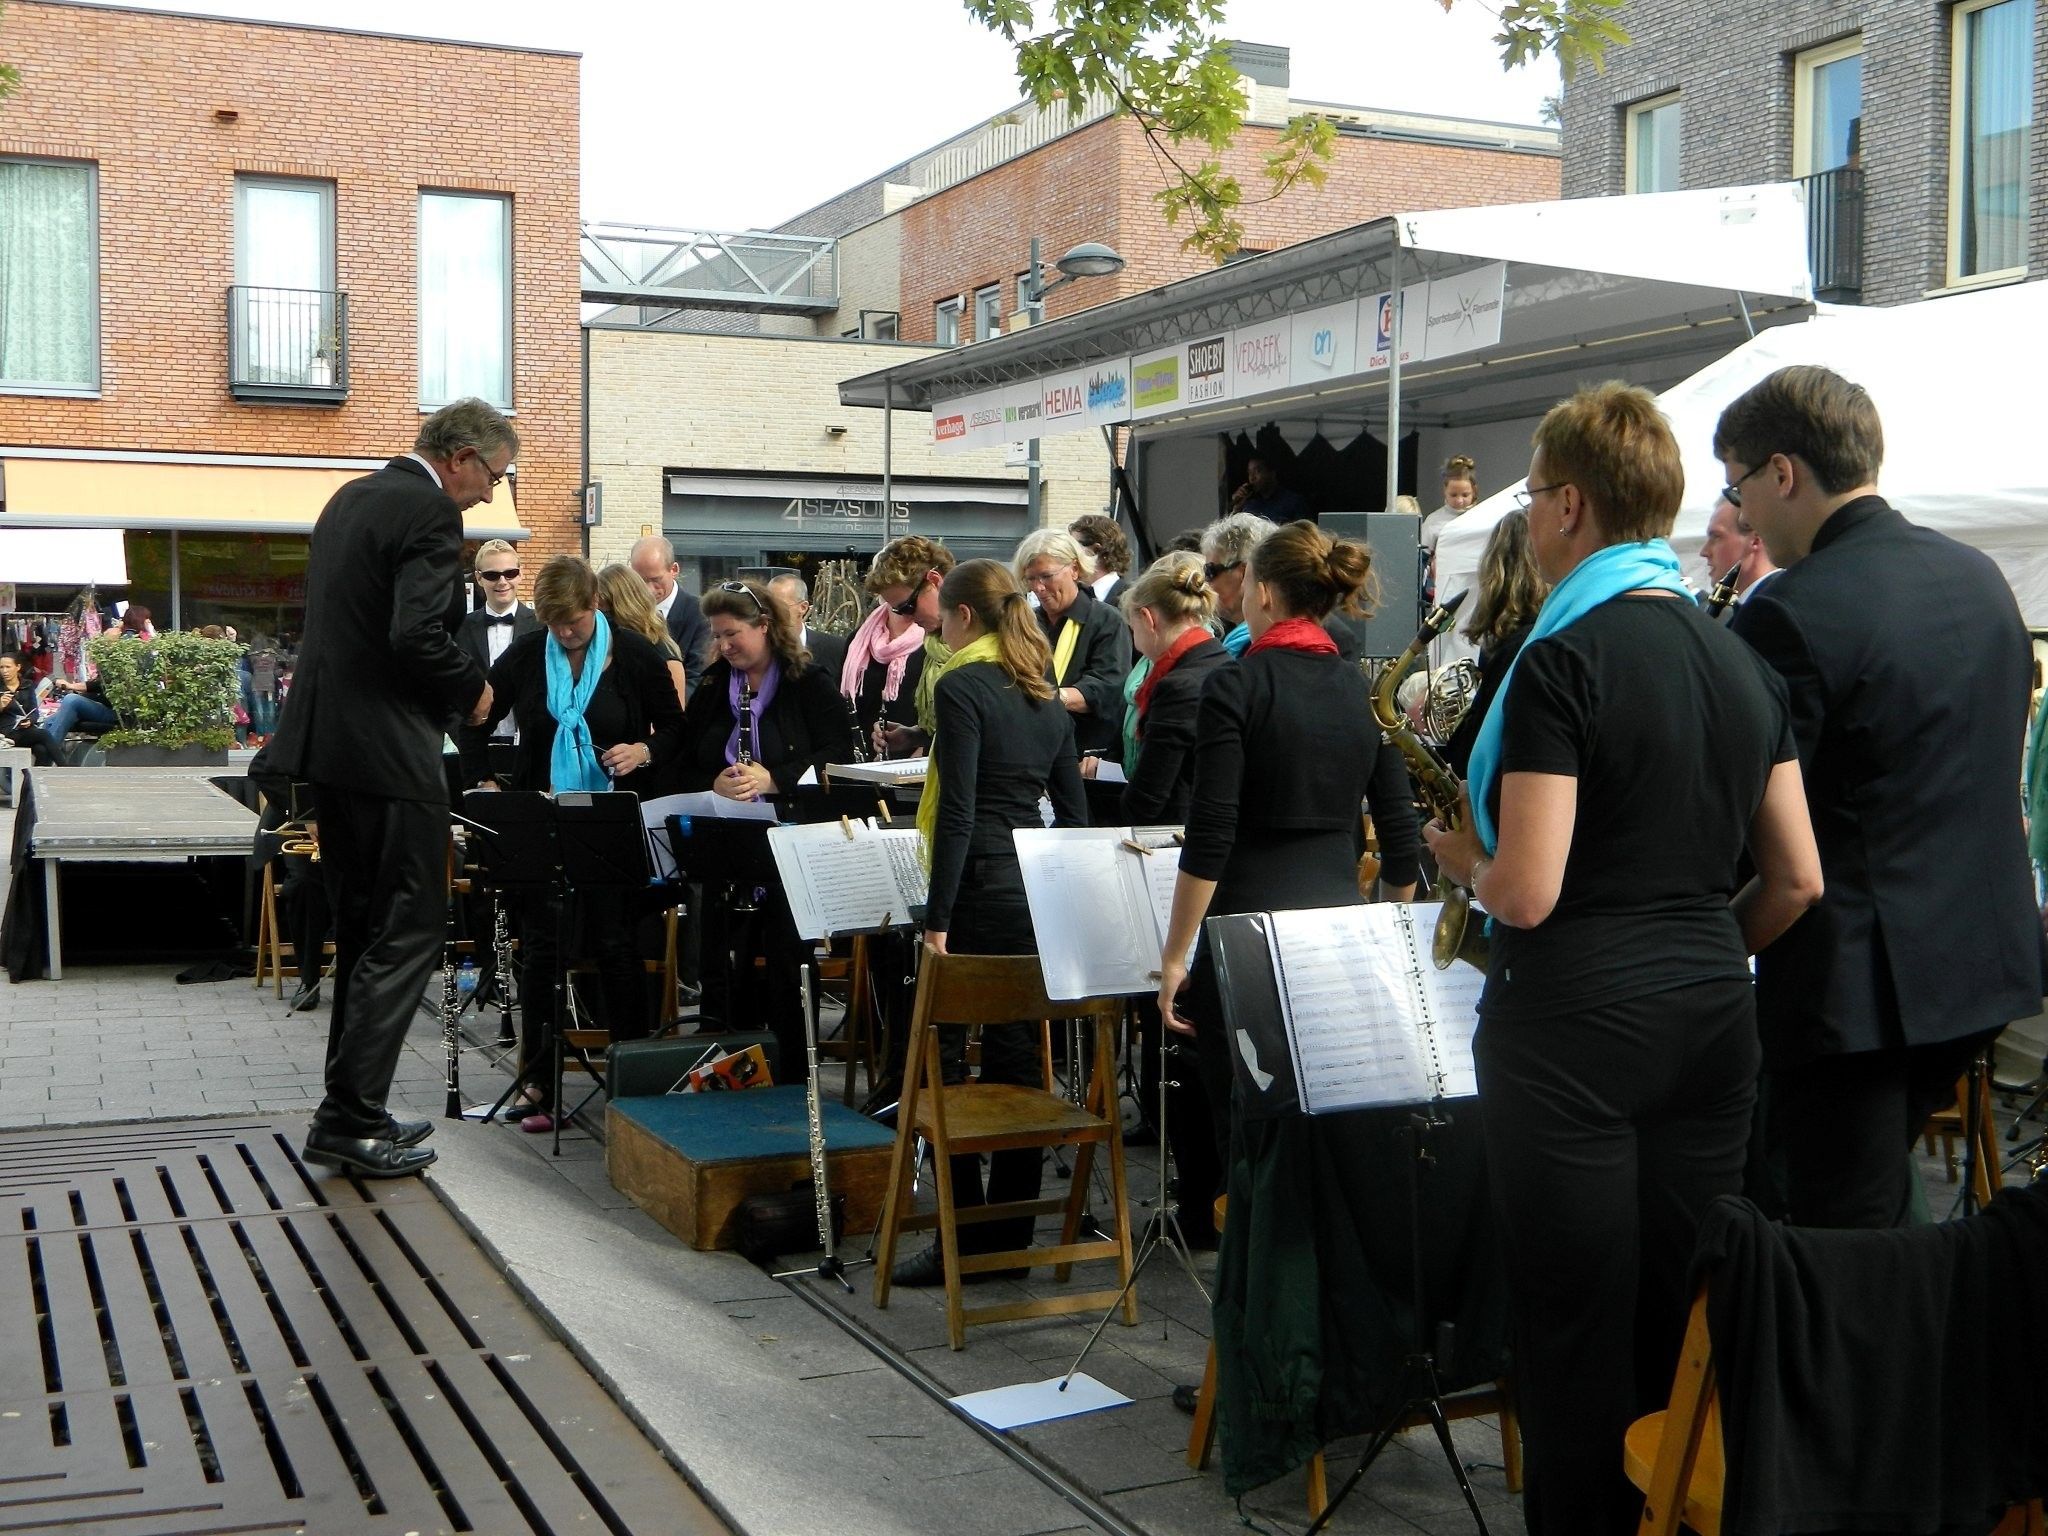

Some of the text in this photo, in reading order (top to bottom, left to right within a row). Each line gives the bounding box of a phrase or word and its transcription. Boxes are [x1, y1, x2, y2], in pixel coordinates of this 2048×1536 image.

[1189, 342, 1223, 375] SHOEBY
[1235, 332, 1281, 373] VERBEEK
[1370, 354, 1388, 367] Dick
[1045, 385, 1082, 416] HEMA
[1190, 379, 1223, 401] FASHION
[936, 419, 965, 436] verhage
